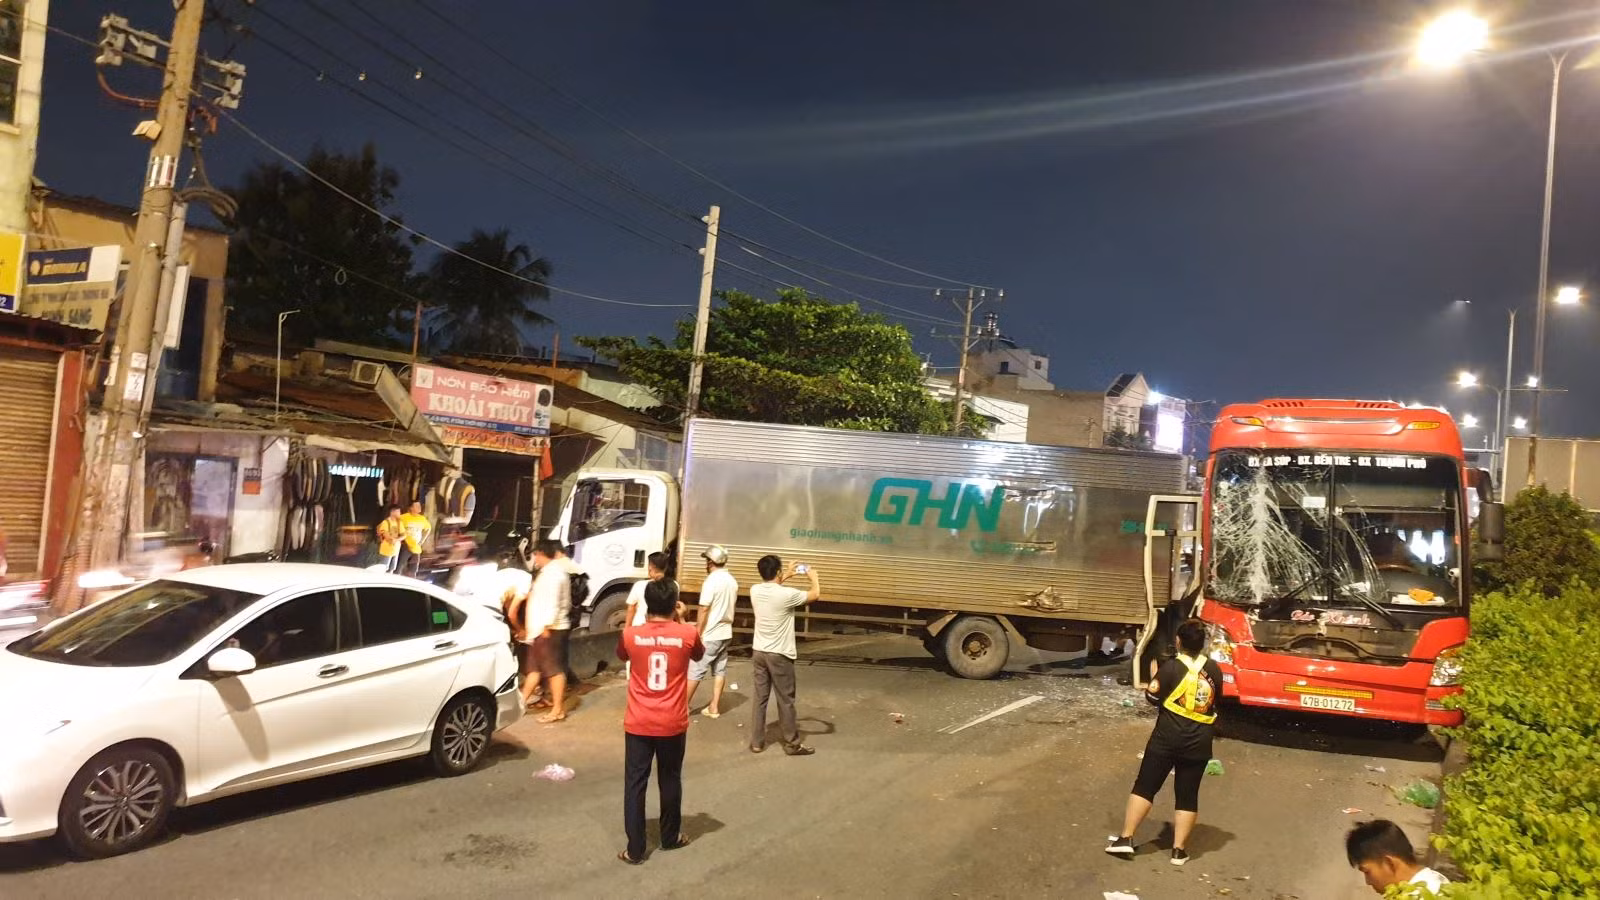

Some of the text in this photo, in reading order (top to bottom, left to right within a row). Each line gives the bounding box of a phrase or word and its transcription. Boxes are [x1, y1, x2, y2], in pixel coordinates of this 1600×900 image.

[437, 375, 466, 390] NÓN
[428, 392, 532, 422] KHOÁI THÚY
[1334, 456, 1352, 467] TRE
[864, 477, 1006, 532] GHN
[647, 651, 668, 691] 8
